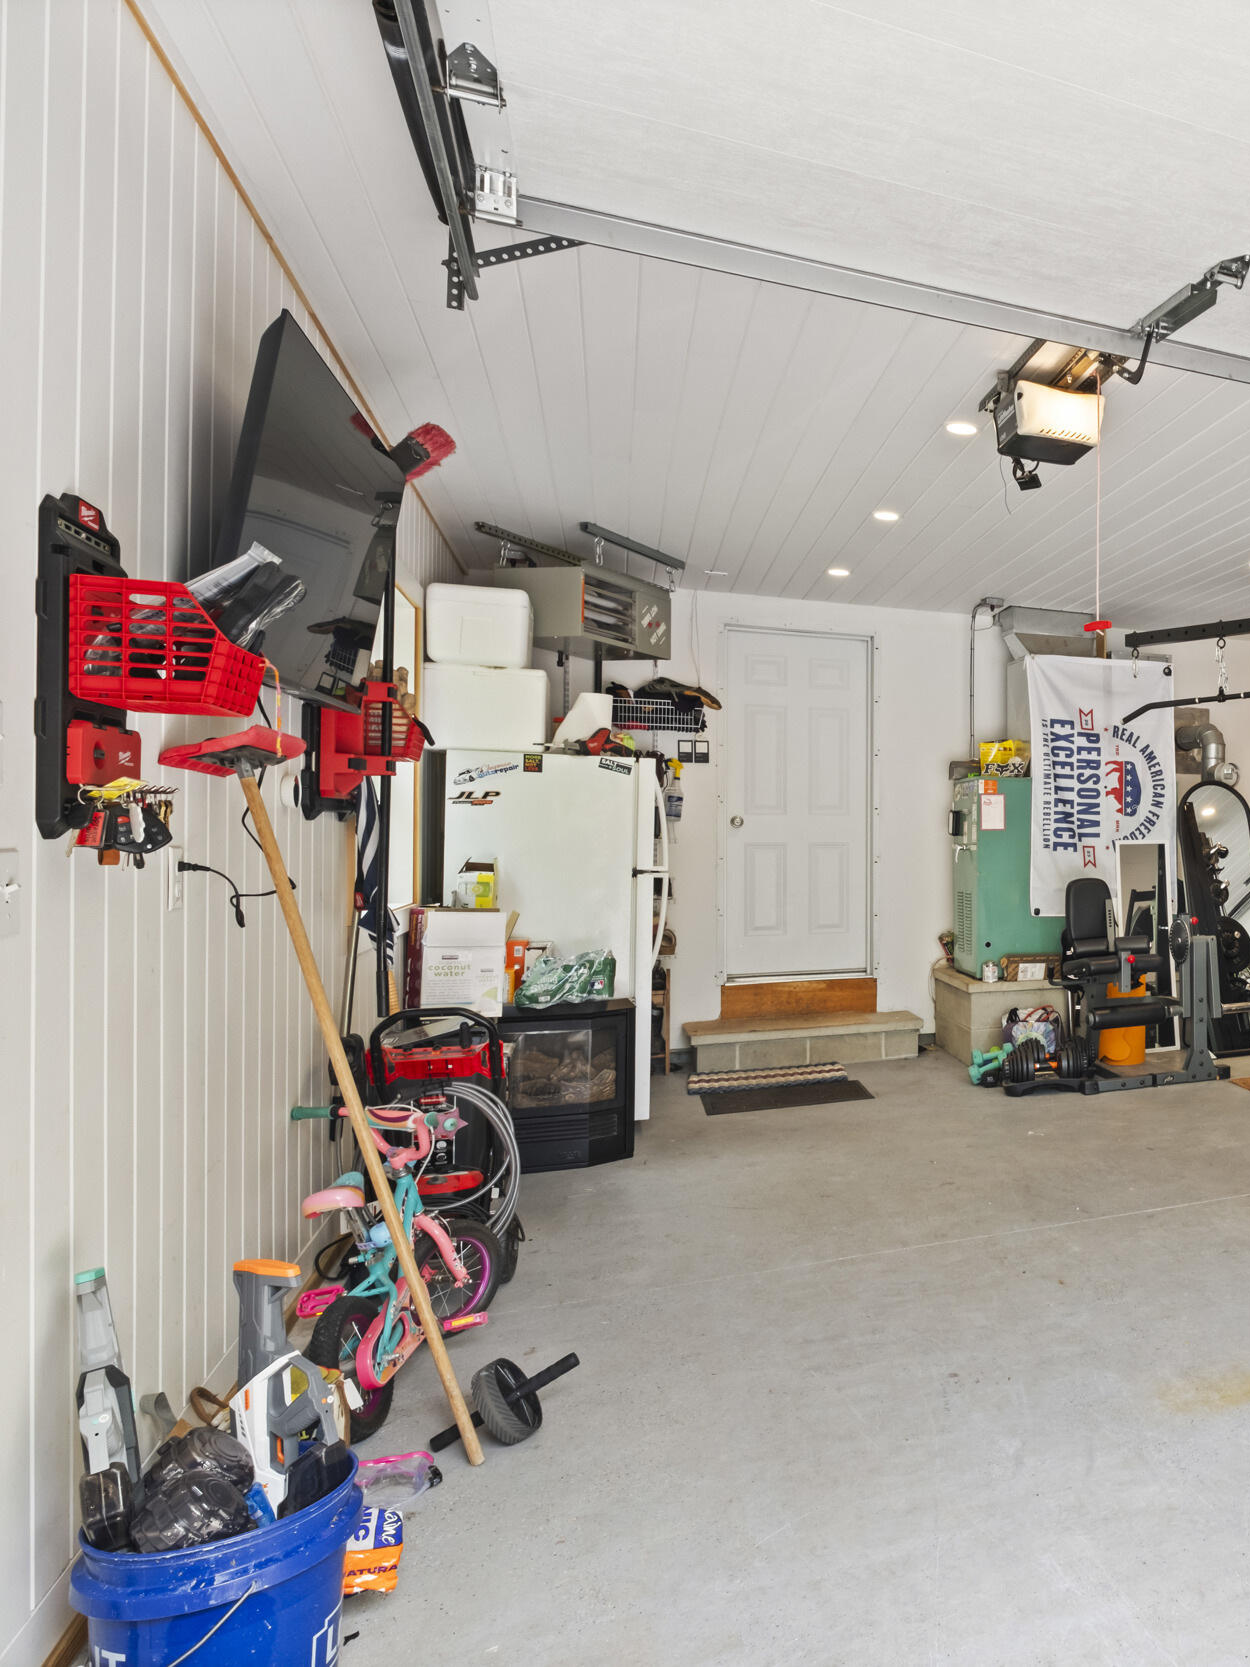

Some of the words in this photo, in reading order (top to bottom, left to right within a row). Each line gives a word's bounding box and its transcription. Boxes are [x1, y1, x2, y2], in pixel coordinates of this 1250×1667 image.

[1041, 719, 1048, 728] IS
[1042, 732, 1050, 748] THE
[1042, 752, 1051, 796] ULTIMATE
[1112, 725, 1140, 749] REAL
[1139, 744, 1166, 809] AMERICAN
[448, 791, 501, 800] JLP
[1049, 718, 1077, 852] EXCELLENCE
[1076, 731, 1101, 842] PERSONAL
[1042, 801, 1051, 849] REBELLION
[428, 964, 472, 972] coconut
[344, 1564, 397, 1577] ATURA
